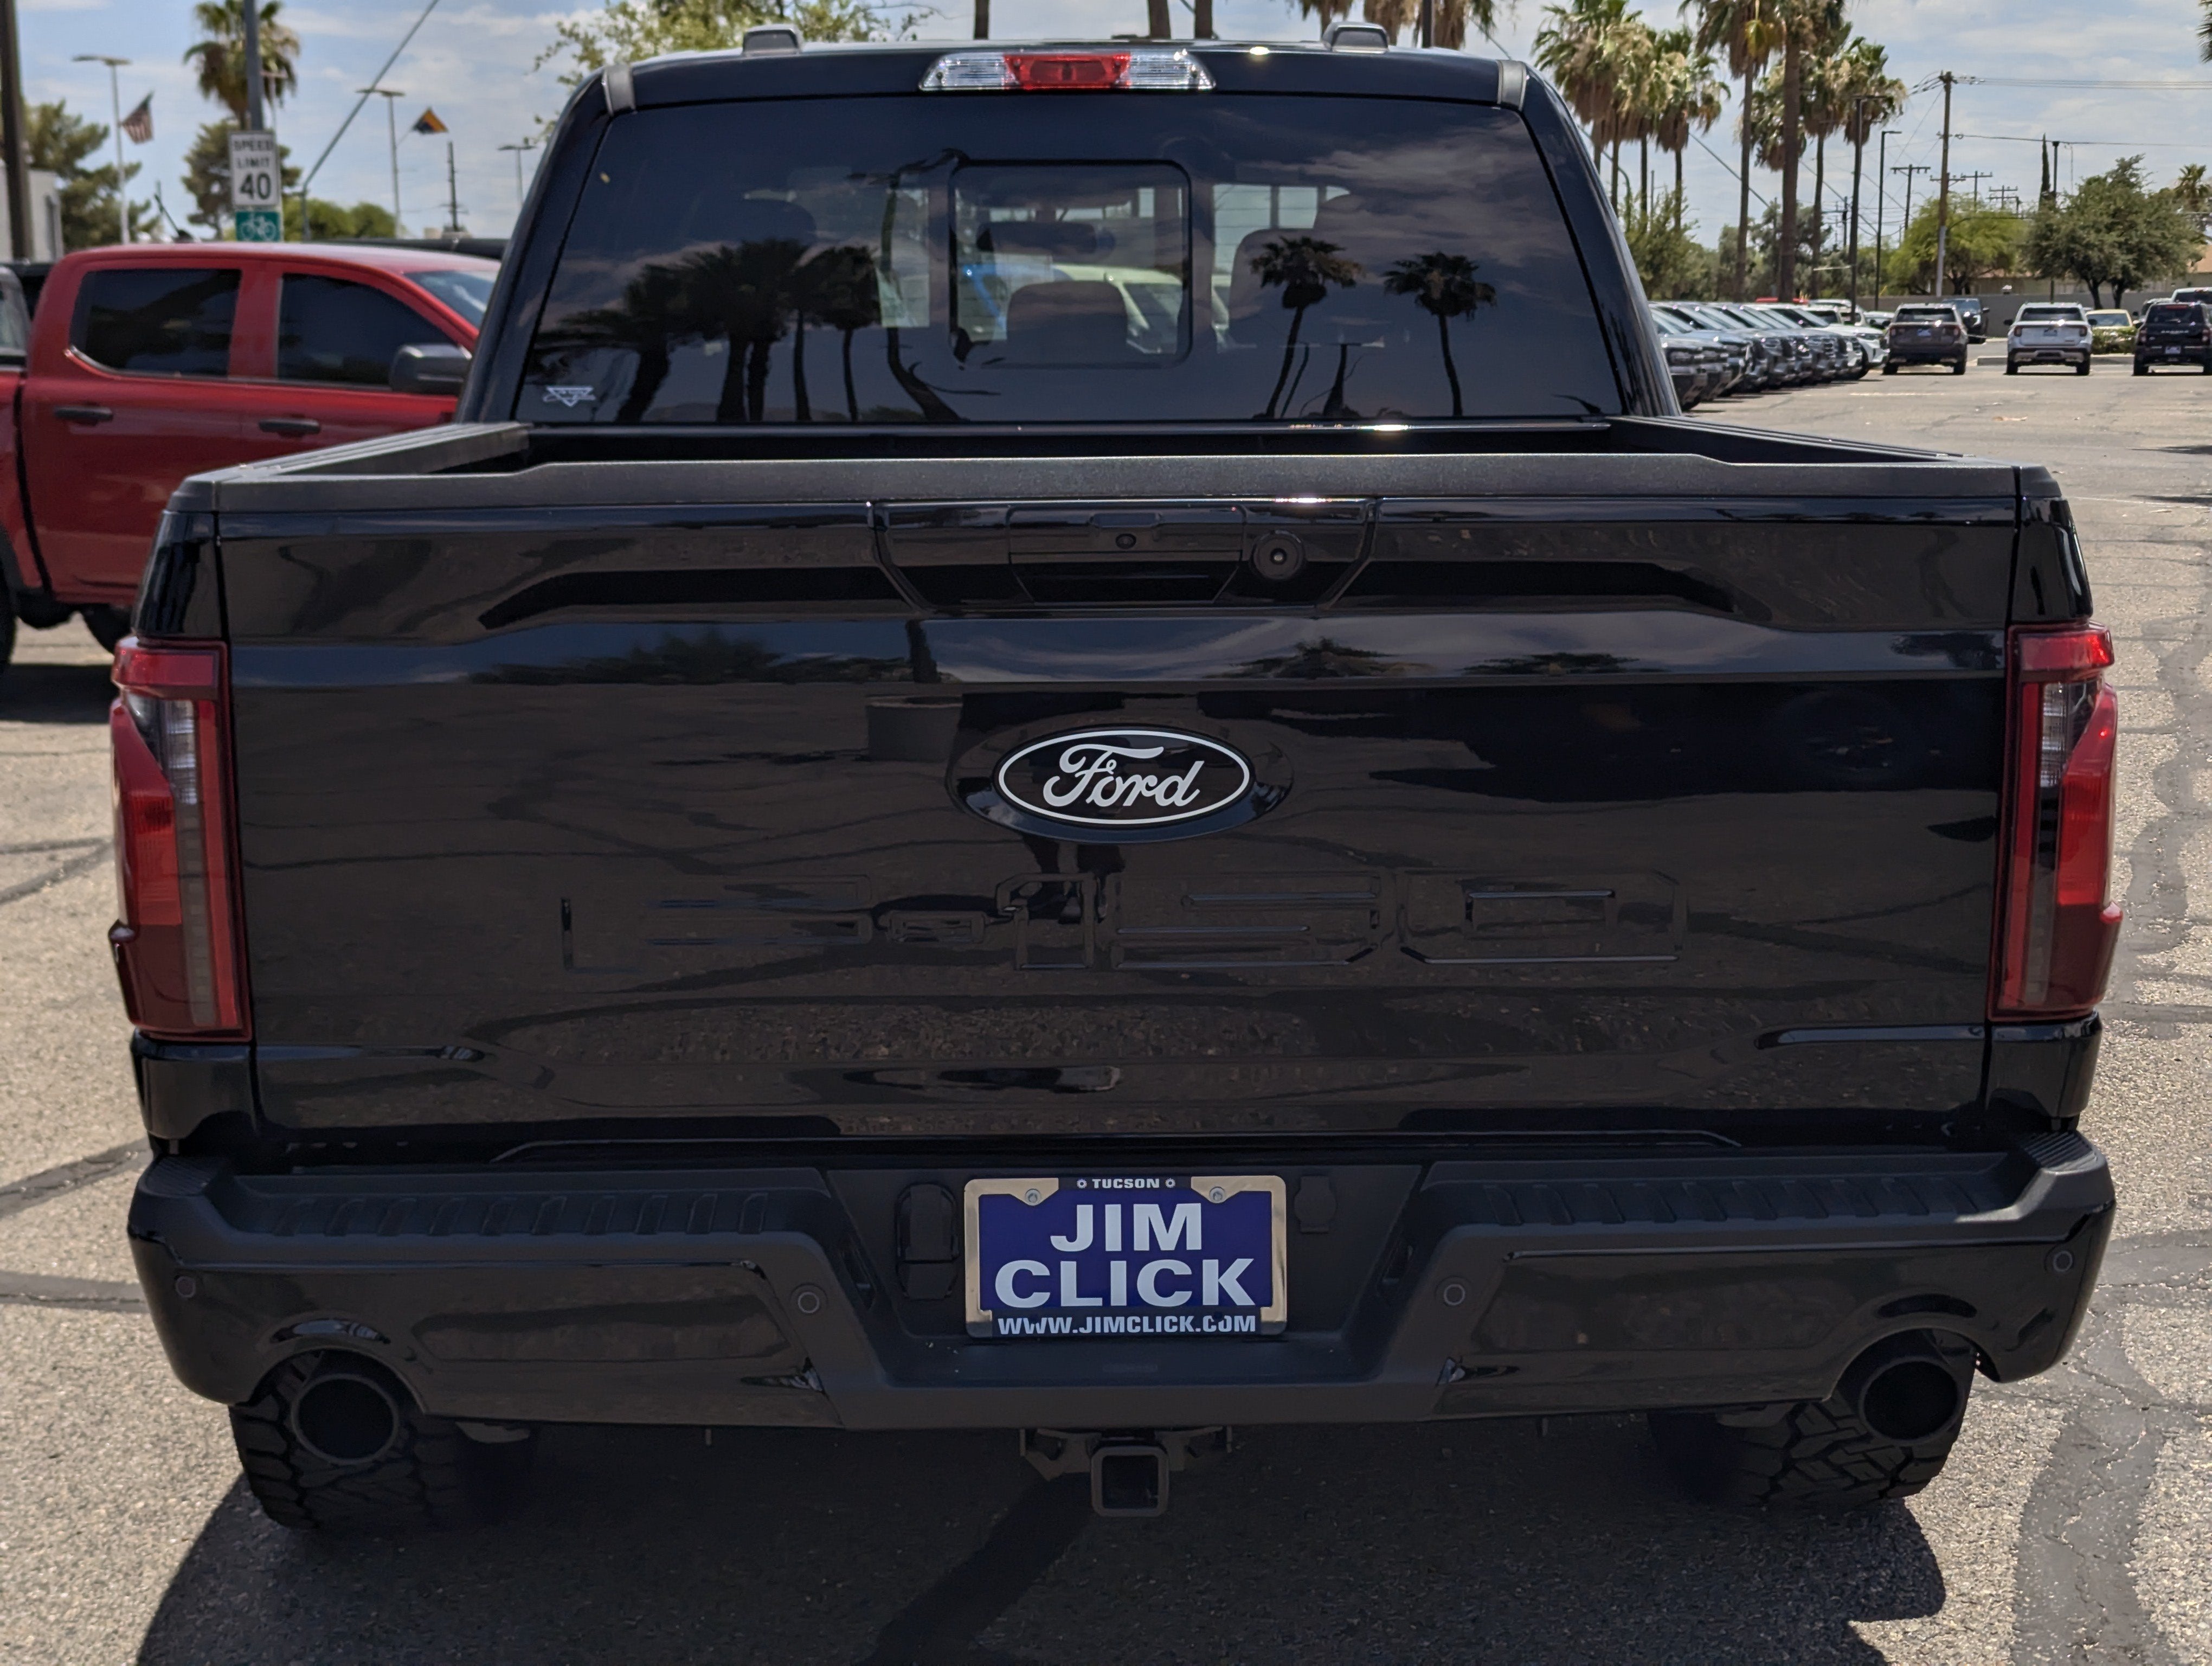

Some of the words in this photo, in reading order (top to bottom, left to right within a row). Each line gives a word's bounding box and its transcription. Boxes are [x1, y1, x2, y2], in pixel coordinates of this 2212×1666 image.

[234, 139, 274, 151] SPEED
[237, 157, 270, 169] LIMIT
[240, 172, 271, 200] 40
[1043, 743, 1205, 808] Ford
[1092, 1178, 1160, 1189] TUCSON
[1050, 1202, 1202, 1252] JIM
[994, 1258, 1256, 1309] CLICK
[998, 1315, 1256, 1335] WWW.JIMCLICK.COM
